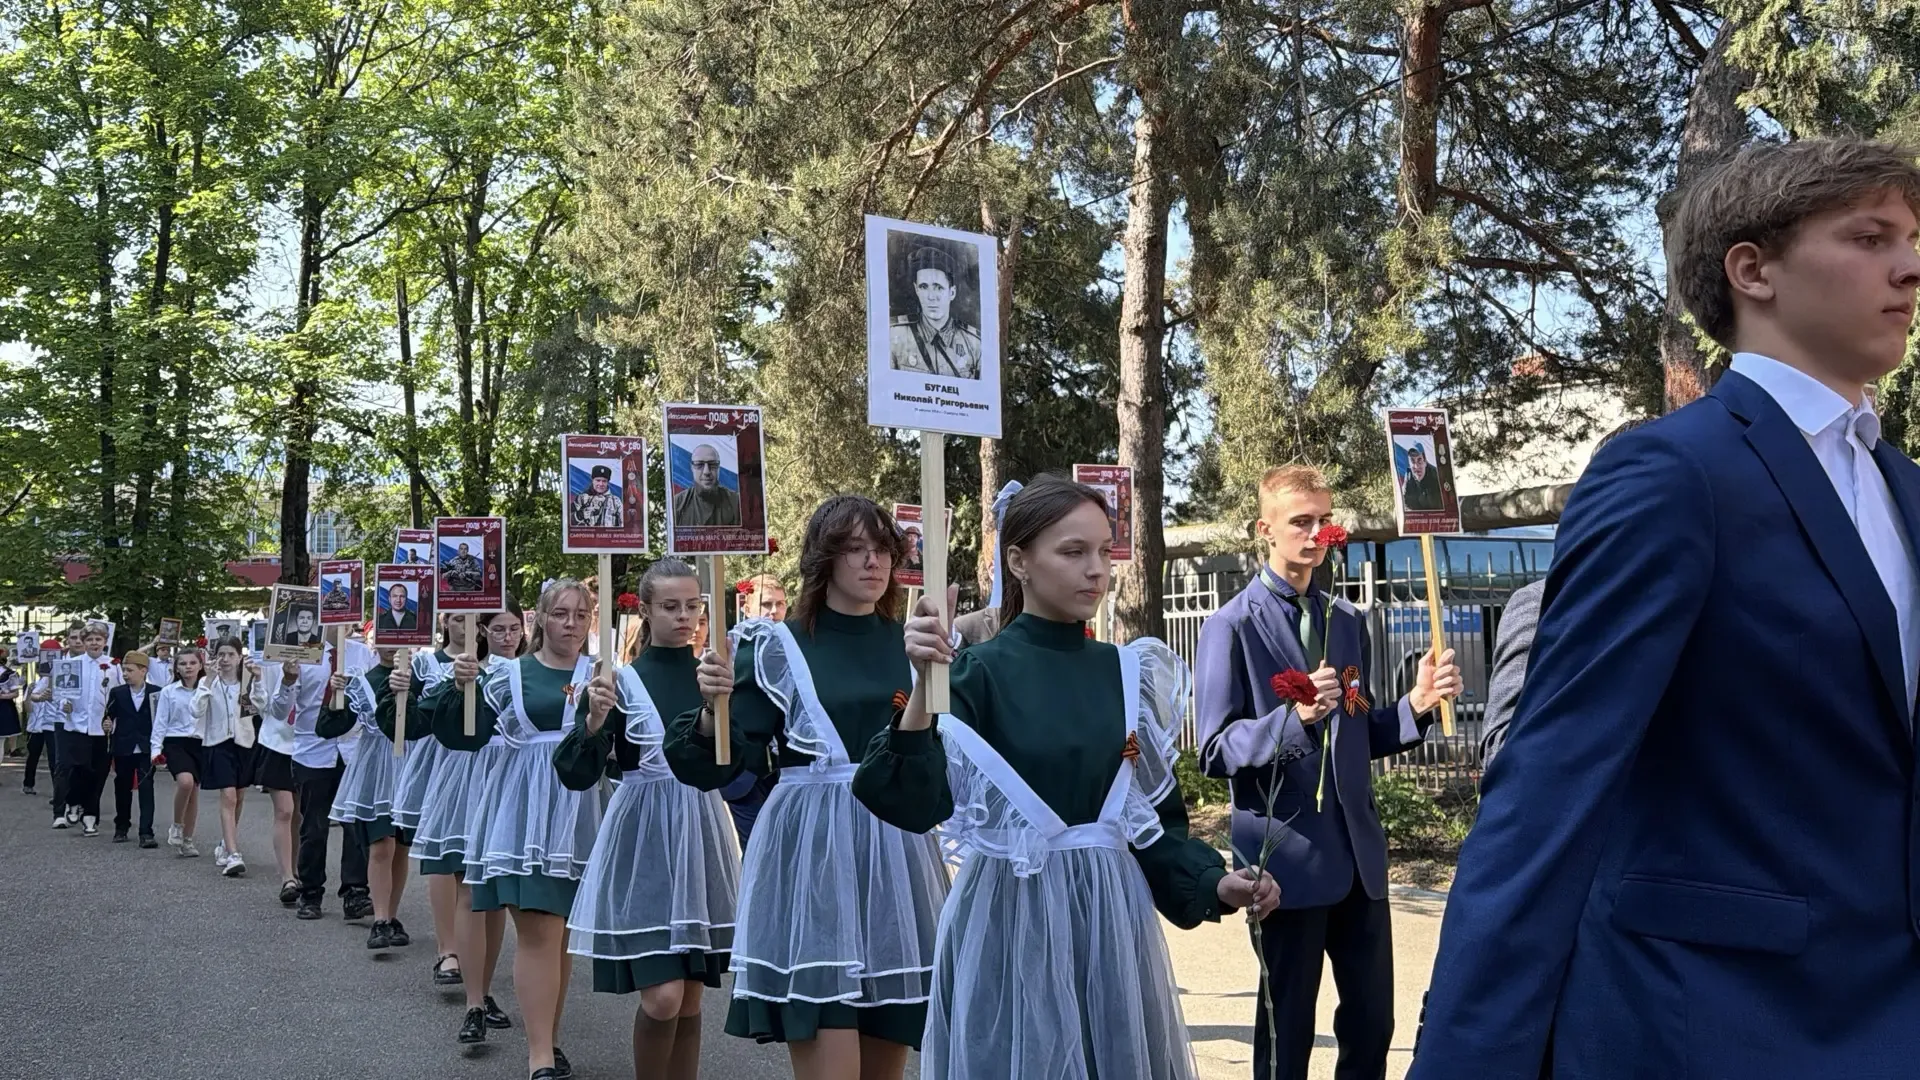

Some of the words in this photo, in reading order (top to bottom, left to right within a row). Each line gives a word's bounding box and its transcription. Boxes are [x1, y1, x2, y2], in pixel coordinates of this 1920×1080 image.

[924, 383, 960, 395] БУГАЕЦ
[894, 392, 933, 404] Николай
[935, 397, 990, 410] Григорьевич
